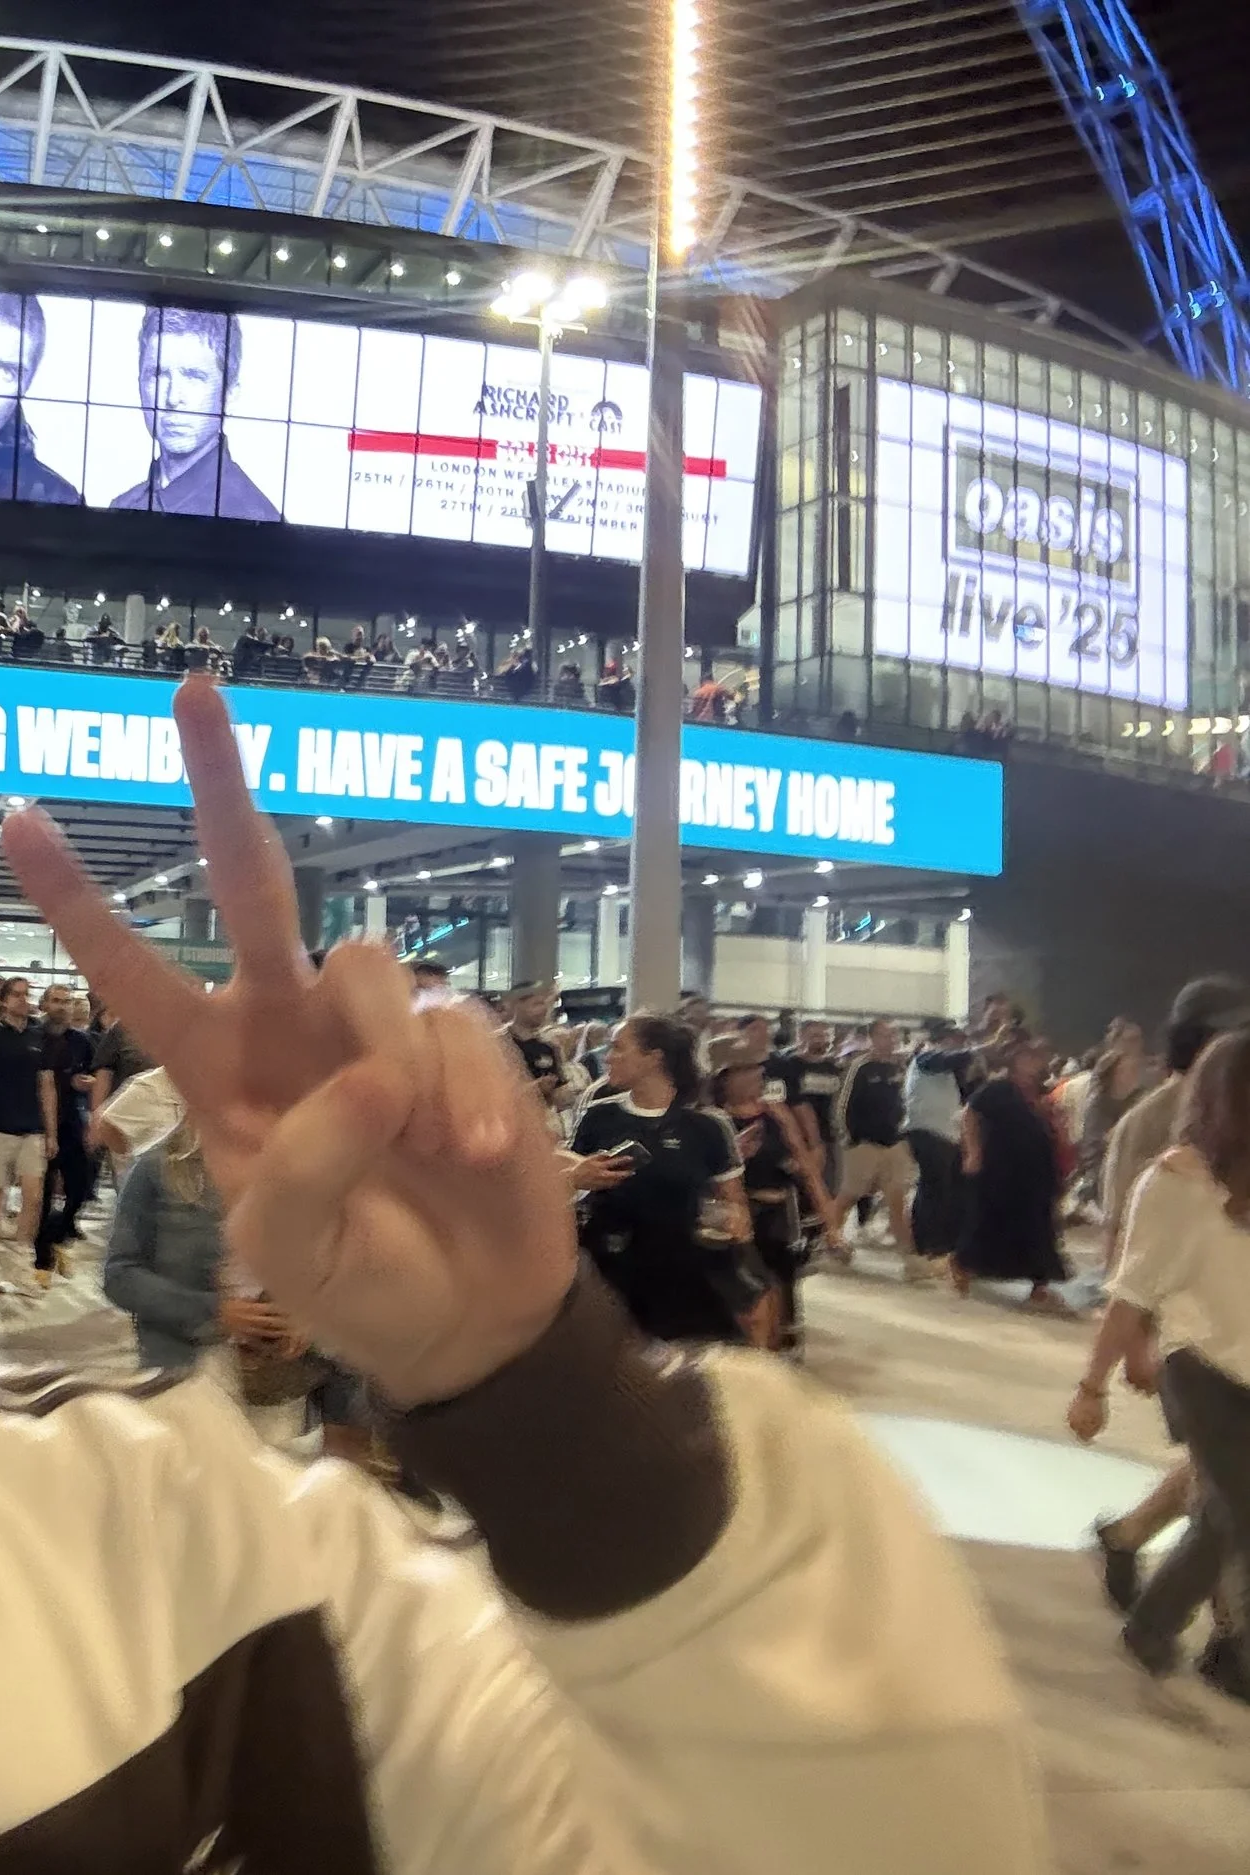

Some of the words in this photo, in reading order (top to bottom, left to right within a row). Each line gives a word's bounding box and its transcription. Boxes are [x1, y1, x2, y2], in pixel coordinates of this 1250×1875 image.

[589, 418, 623, 434] CAST
[431, 461, 497, 477] LONDON
[354, 472, 392, 484] 25TH
[441, 500, 481, 512] 27TH
[965, 477, 1124, 564] oasis
[940, 571, 1047, 650] live
[297, 727, 423, 801] HAVE
[430, 736, 466, 804] A
[474, 740, 588, 813] SAFE
[594, 749, 782, 833] JRNEY
[786, 770, 896, 846] HOME
